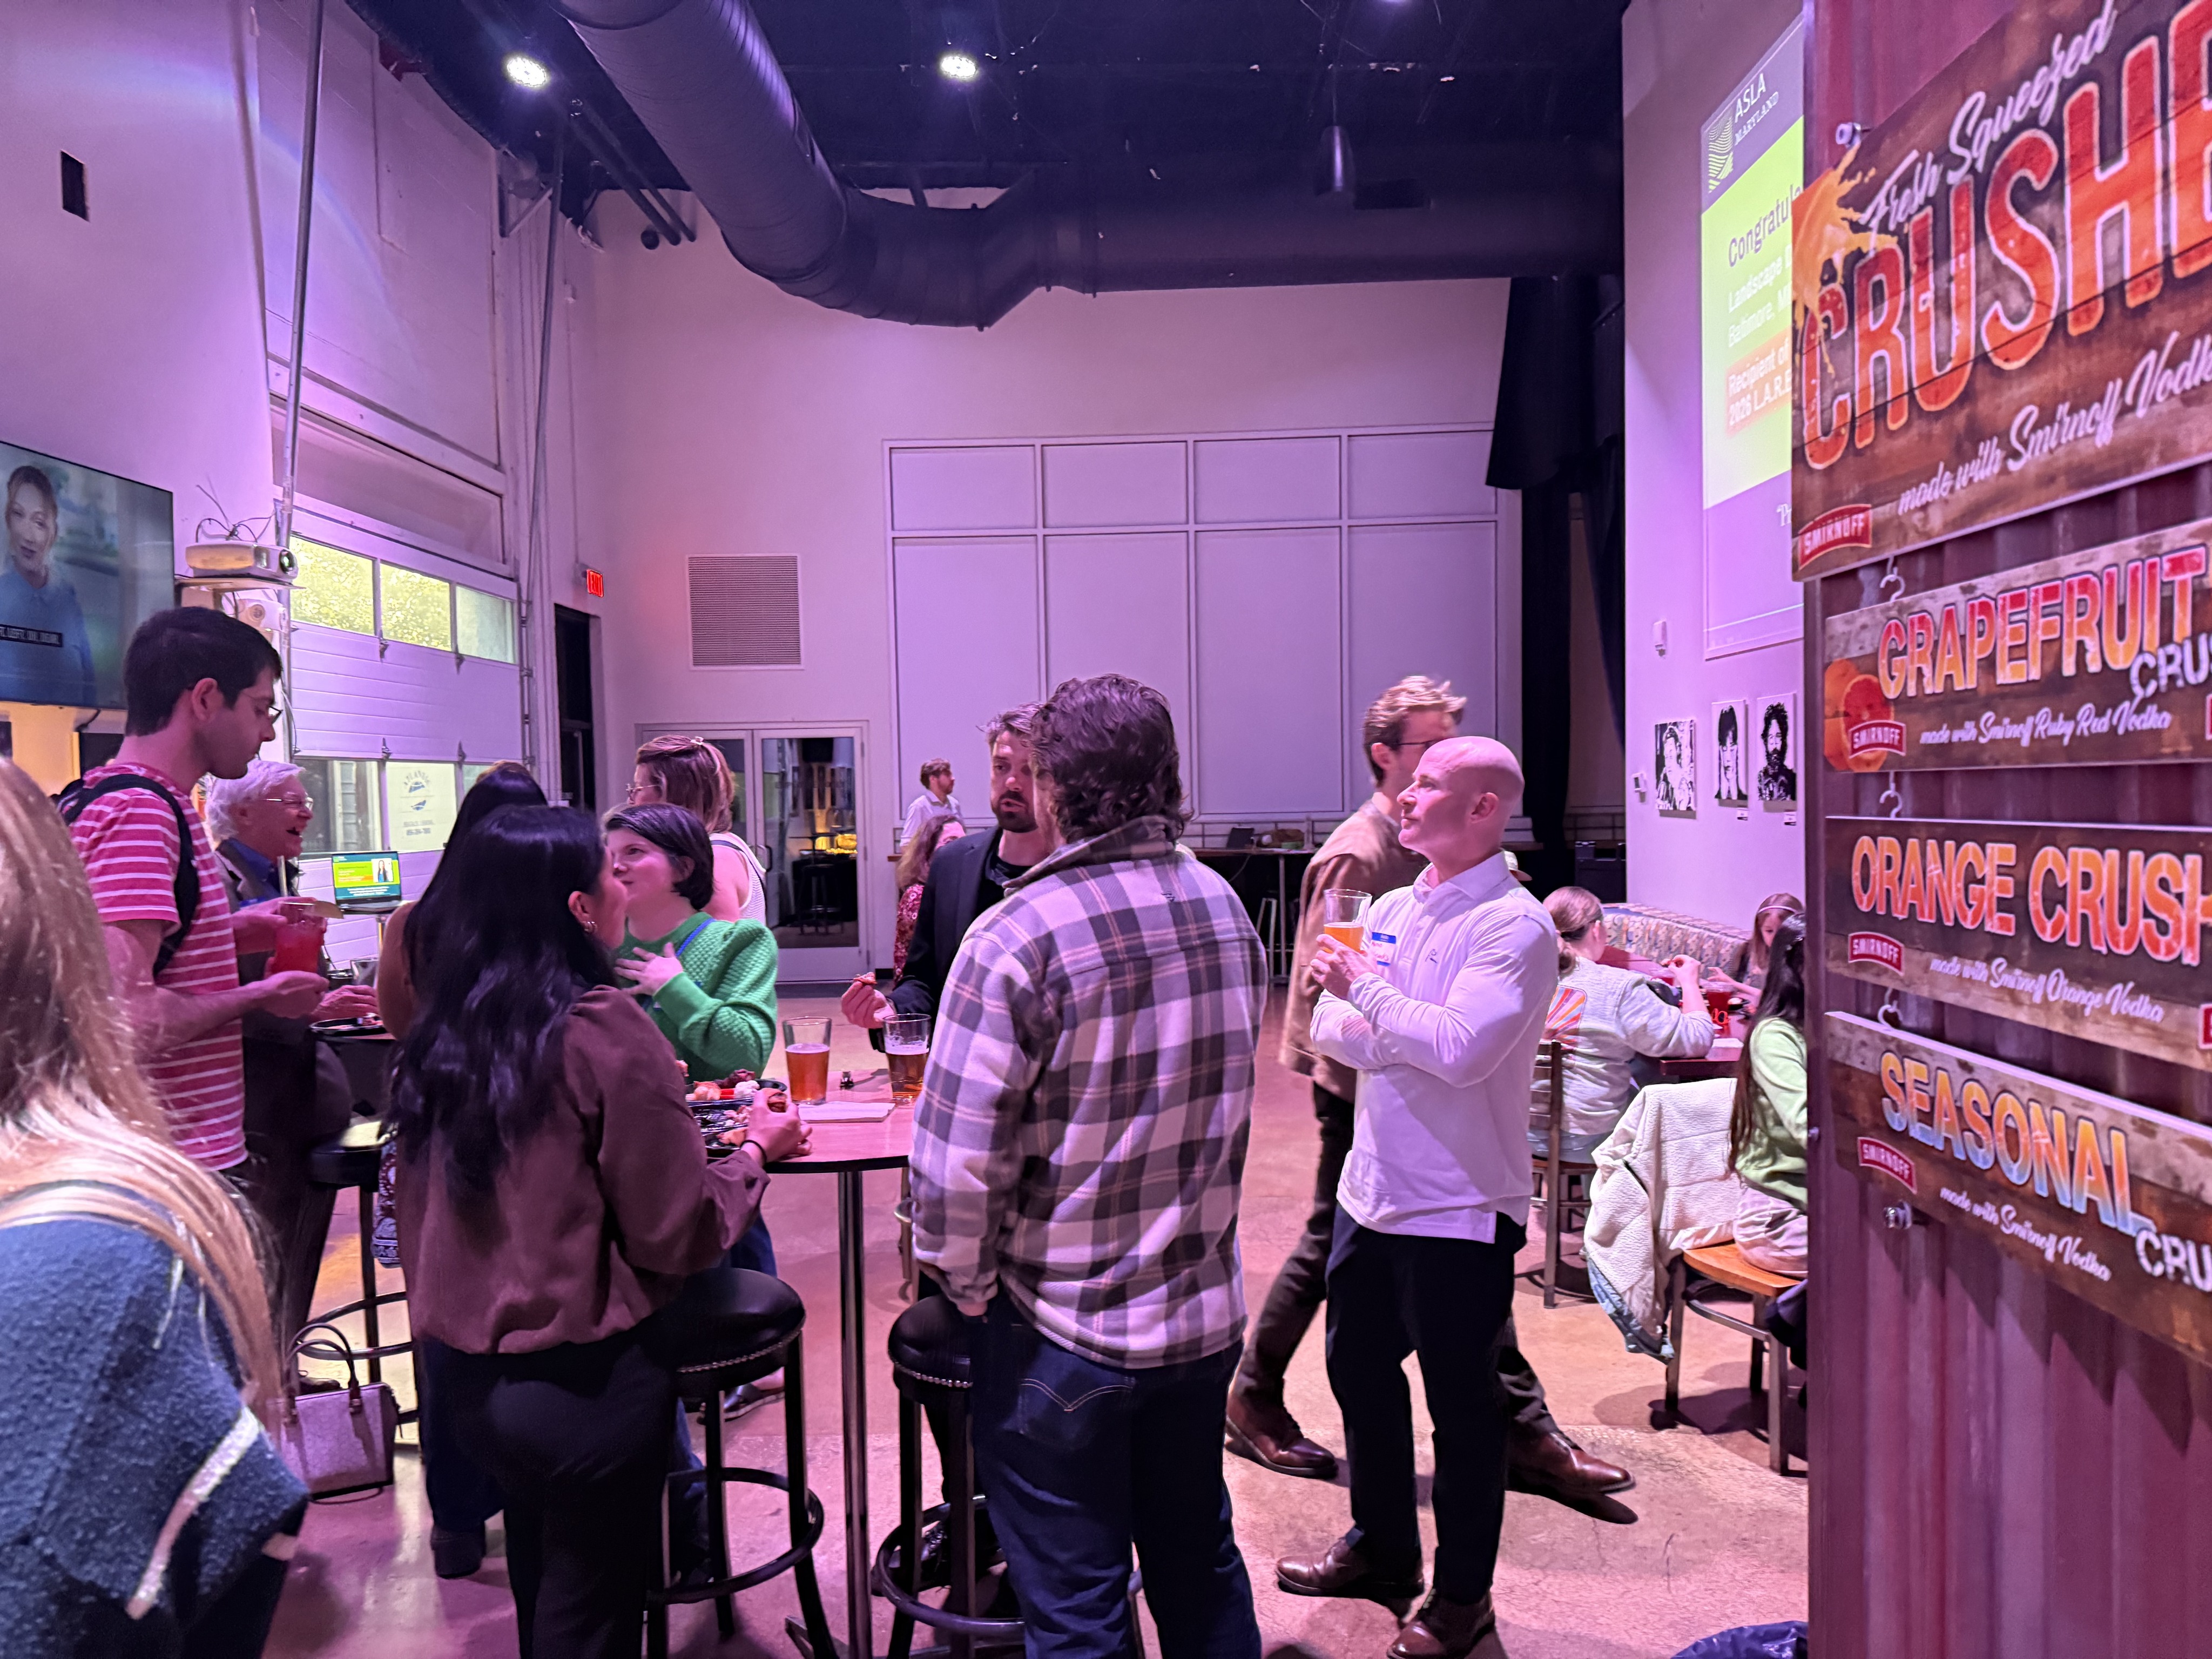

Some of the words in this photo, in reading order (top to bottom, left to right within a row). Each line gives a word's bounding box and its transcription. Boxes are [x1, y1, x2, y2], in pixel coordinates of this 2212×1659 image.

[1735, 73, 1766, 123] ASLA
[1729, 348, 1776, 397] Recipient
[1898, 461, 1954, 516] made
[1954, 435, 2004, 490] with
[2006, 377, 2122, 472] Smirnoff
[1804, 513, 1865, 556] SMIRNOFF
[1878, 544, 2208, 700] GRAPEFRUIT
[2130, 631, 2212, 699] CRU
[1853, 727, 1900, 749] SMIRNOFF
[1978, 711, 2034, 747] Smirnoff
[2034, 707, 2075, 746] Ruby
[2076, 703, 2112, 737] Red
[2112, 694, 2172, 736] Vodka
[1851, 835, 2017, 936] ORANGE
[1852, 939, 1899, 963] SMIRNOFF
[1990, 957, 2047, 1004] Smirnoff
[2046, 968, 2103, 1017] Orange
[2105, 981, 2164, 1023] Vodka
[1862, 1143, 1910, 1179] SMIRNOFF
[1880, 1051, 2157, 1237] SEASONAL
[2000, 1204, 2058, 1263] Smirnoff
[2058, 1236, 2112, 1282] Vodka
